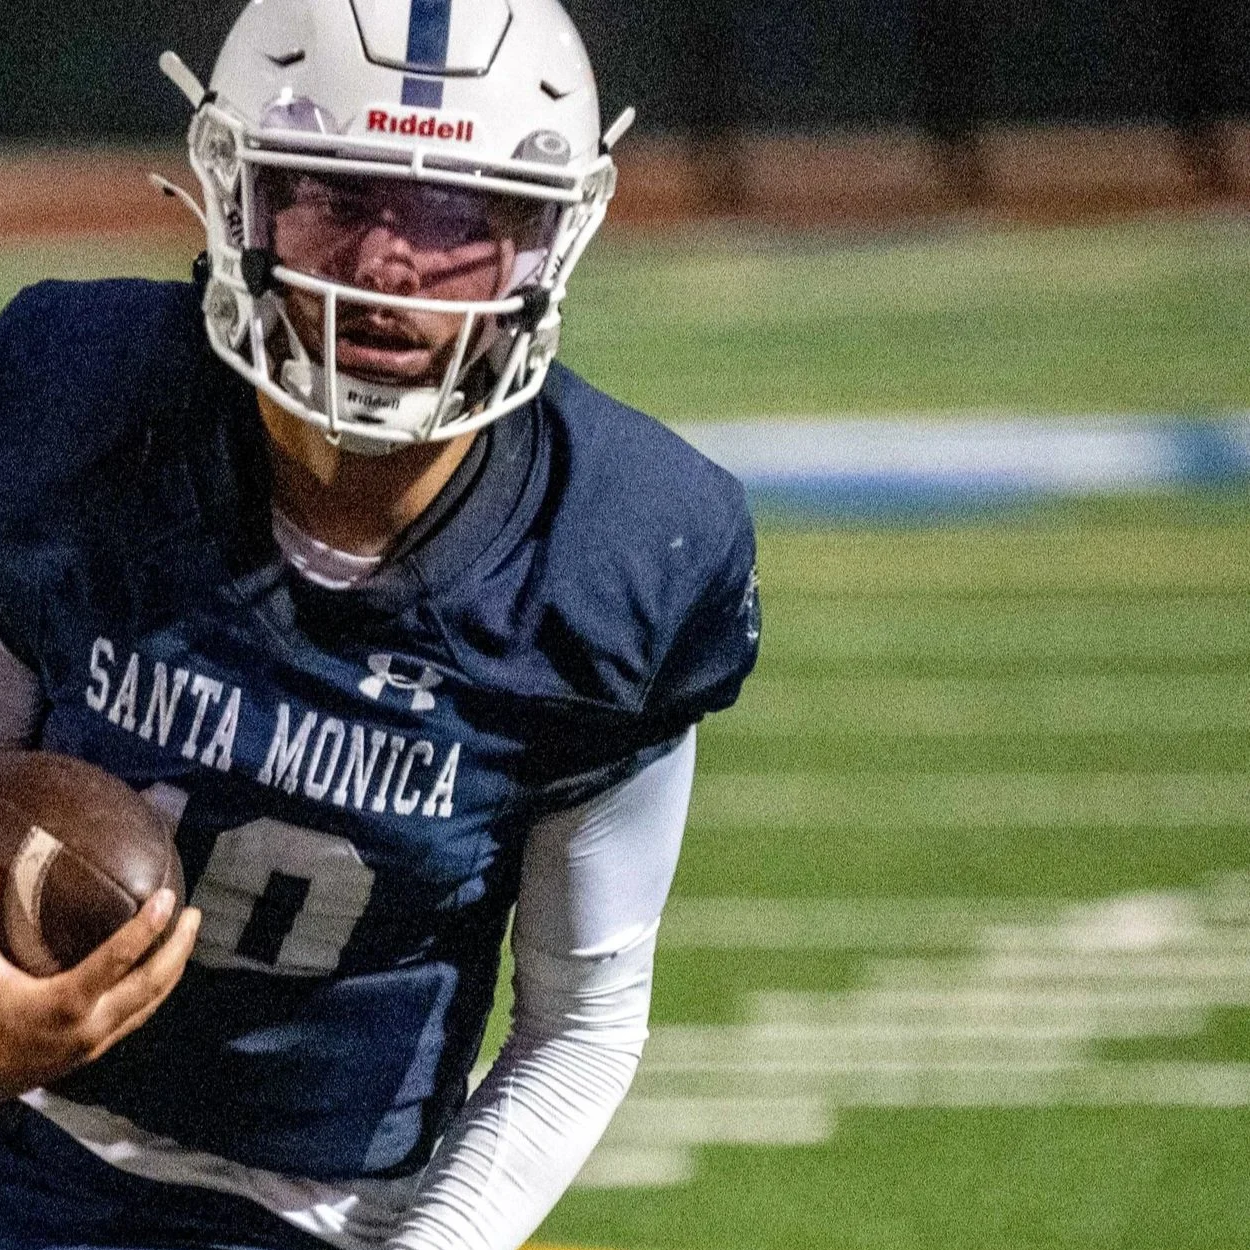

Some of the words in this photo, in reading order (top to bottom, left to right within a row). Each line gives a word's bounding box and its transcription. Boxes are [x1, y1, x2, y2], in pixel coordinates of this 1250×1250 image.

[367, 109, 474, 142] Riddell
[347, 391, 400, 410] Riddell
[86, 636, 241, 772] SANTA
[257, 703, 461, 817] MONICA
[140, 781, 375, 976] 0
